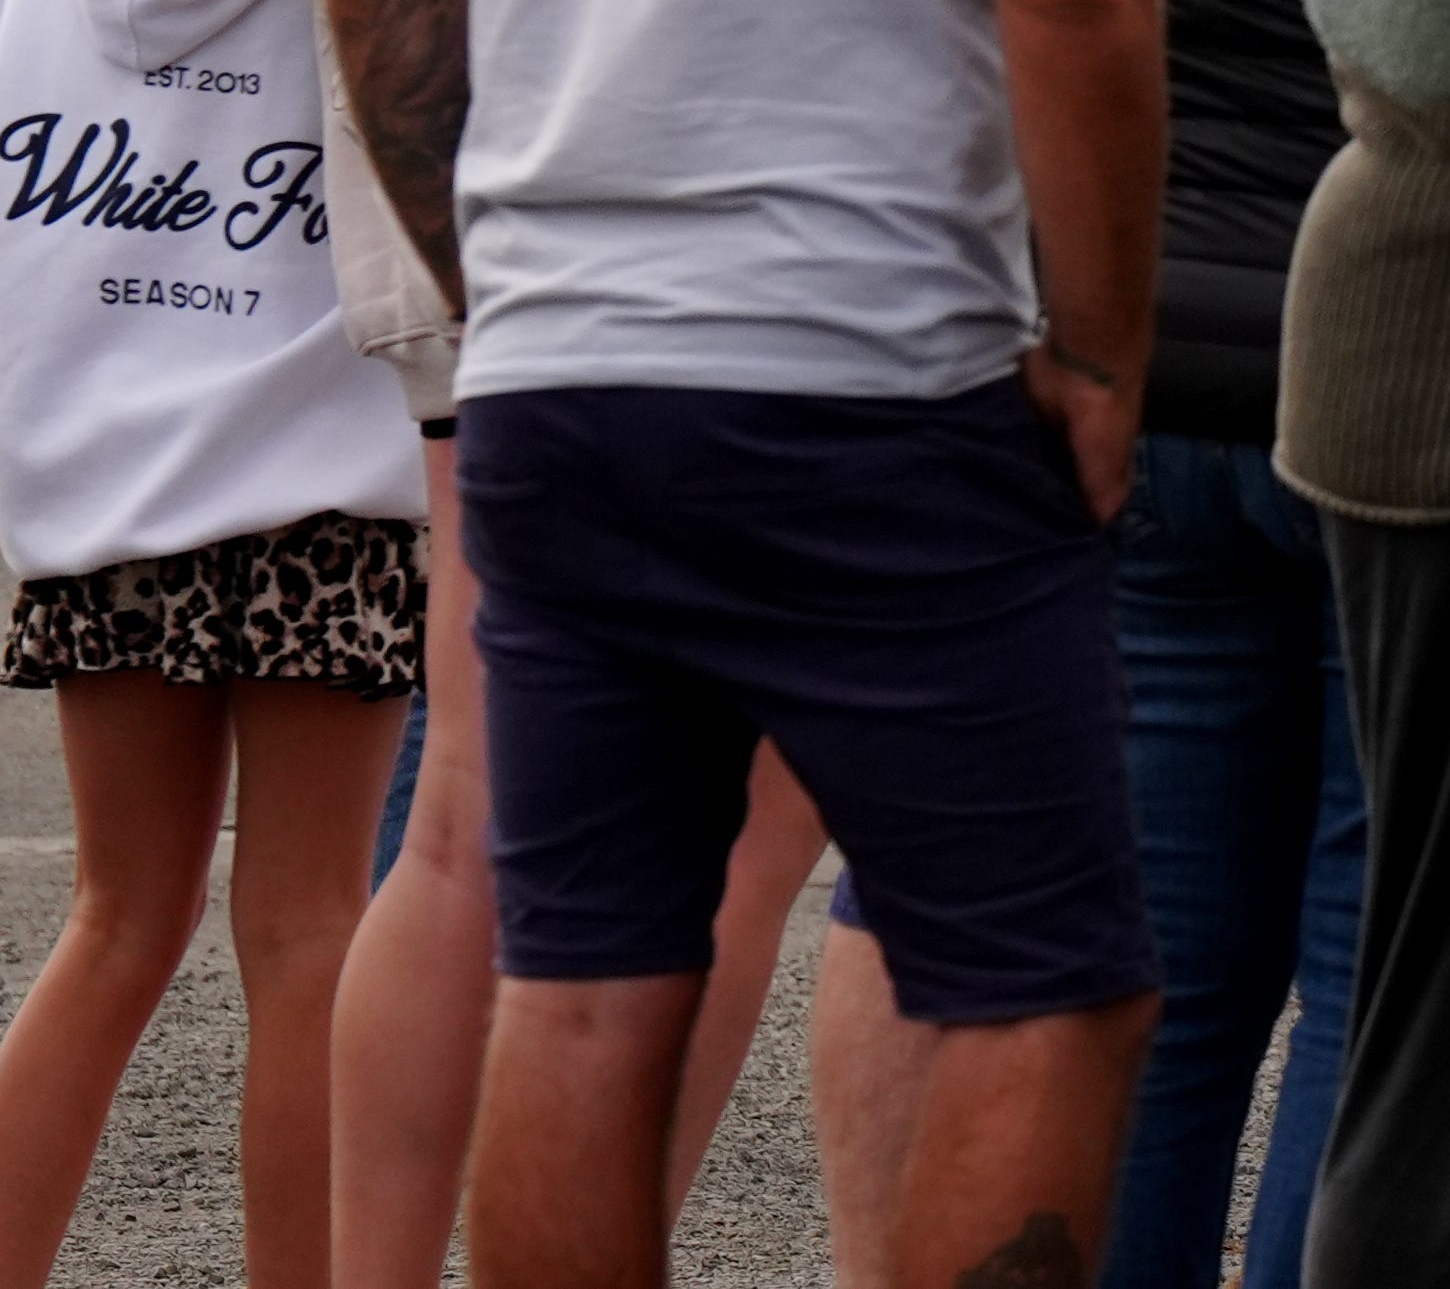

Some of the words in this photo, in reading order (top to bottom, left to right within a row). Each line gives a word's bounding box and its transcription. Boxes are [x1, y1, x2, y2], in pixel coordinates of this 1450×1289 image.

[143, 65, 192, 89] EST.
[197, 69, 262, 96] 2013
[0, 112, 218, 233] White
[224, 140, 330, 252] Fo
[99, 277, 235, 316] SEASON
[243, 289, 262, 317] 7
